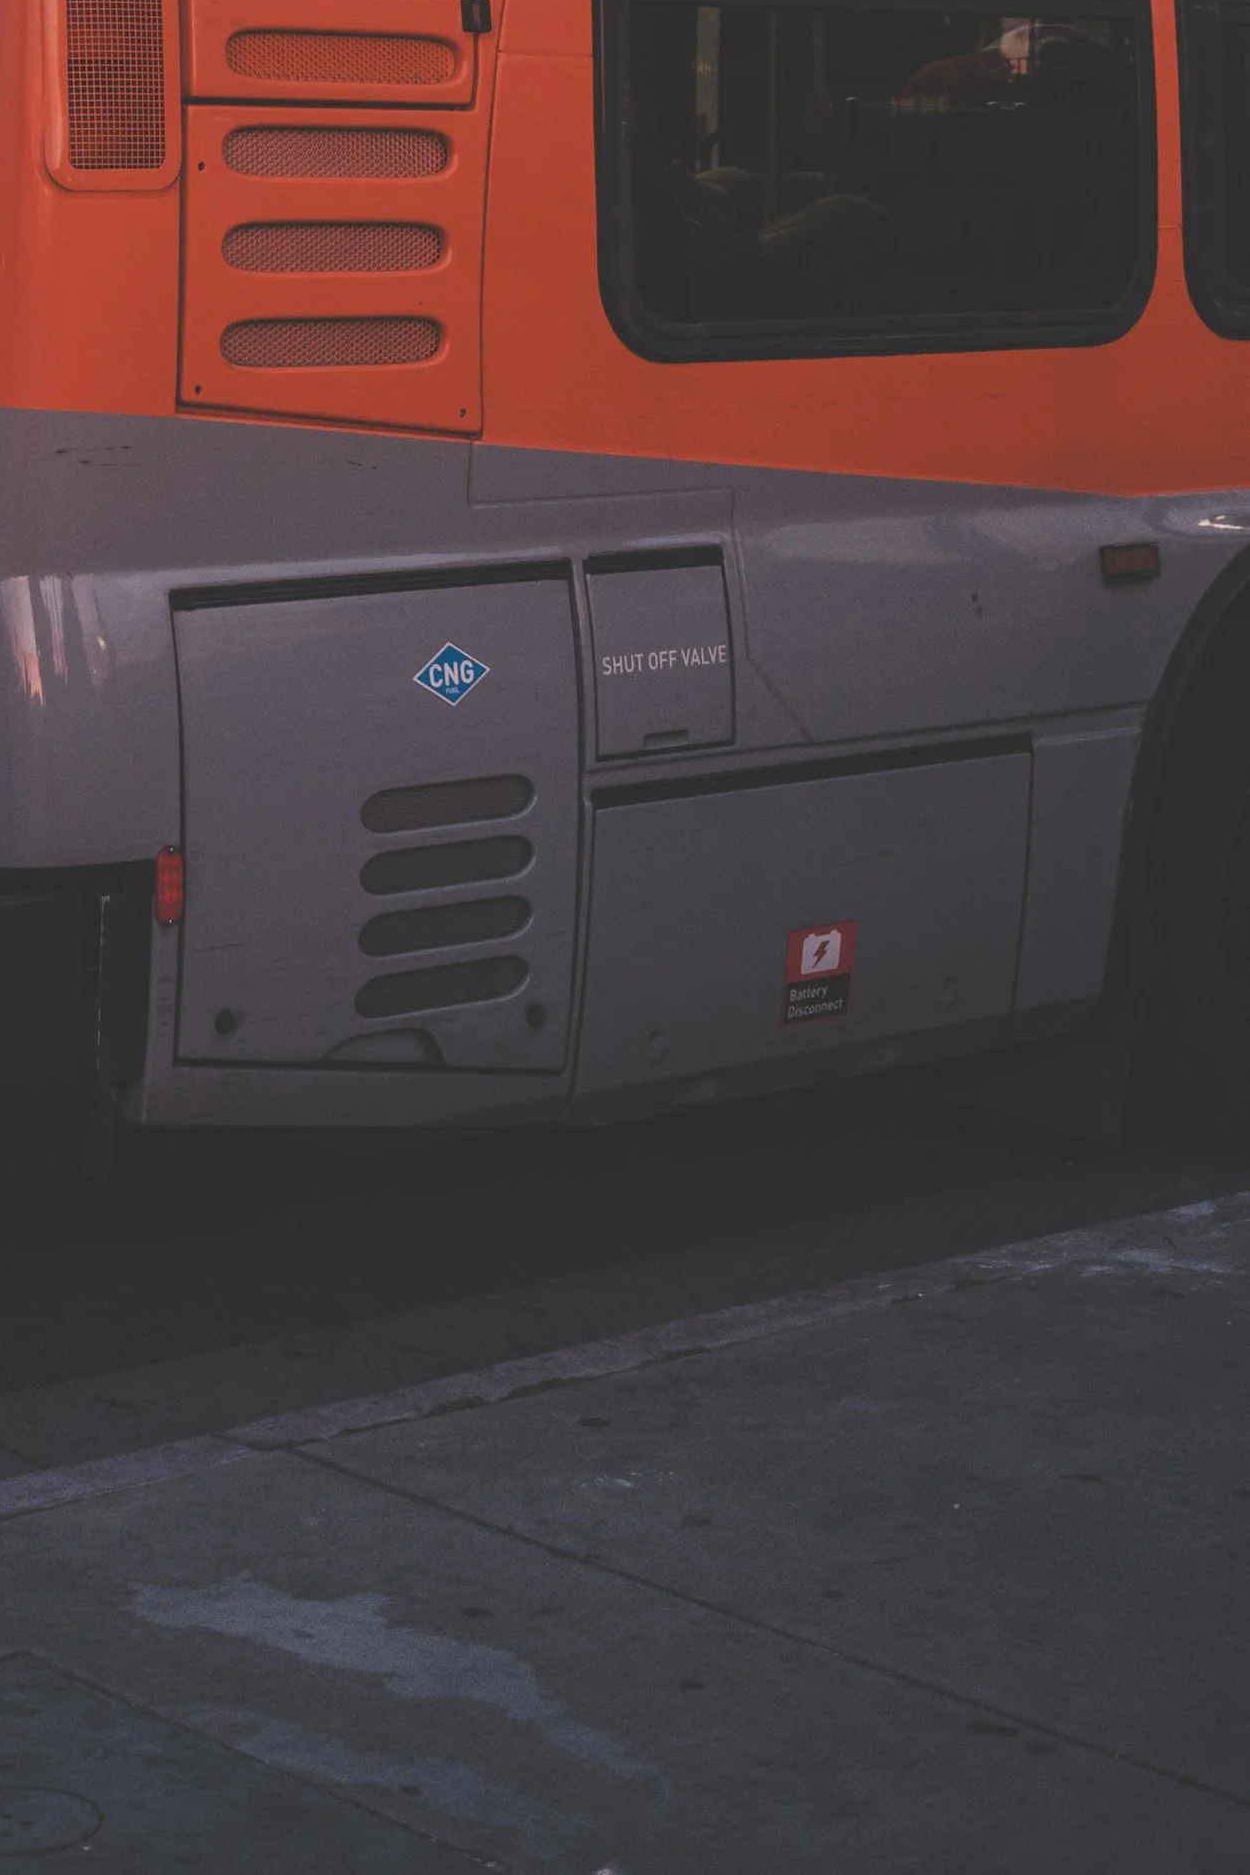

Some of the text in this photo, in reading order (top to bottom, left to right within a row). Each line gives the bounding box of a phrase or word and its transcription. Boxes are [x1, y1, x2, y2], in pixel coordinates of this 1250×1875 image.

[602, 644, 727, 675] SHUT OFF VALVE
[429, 659, 474, 688] CNG
[790, 986, 828, 1001] Battery
[787, 998, 843, 1019] Disconnect
